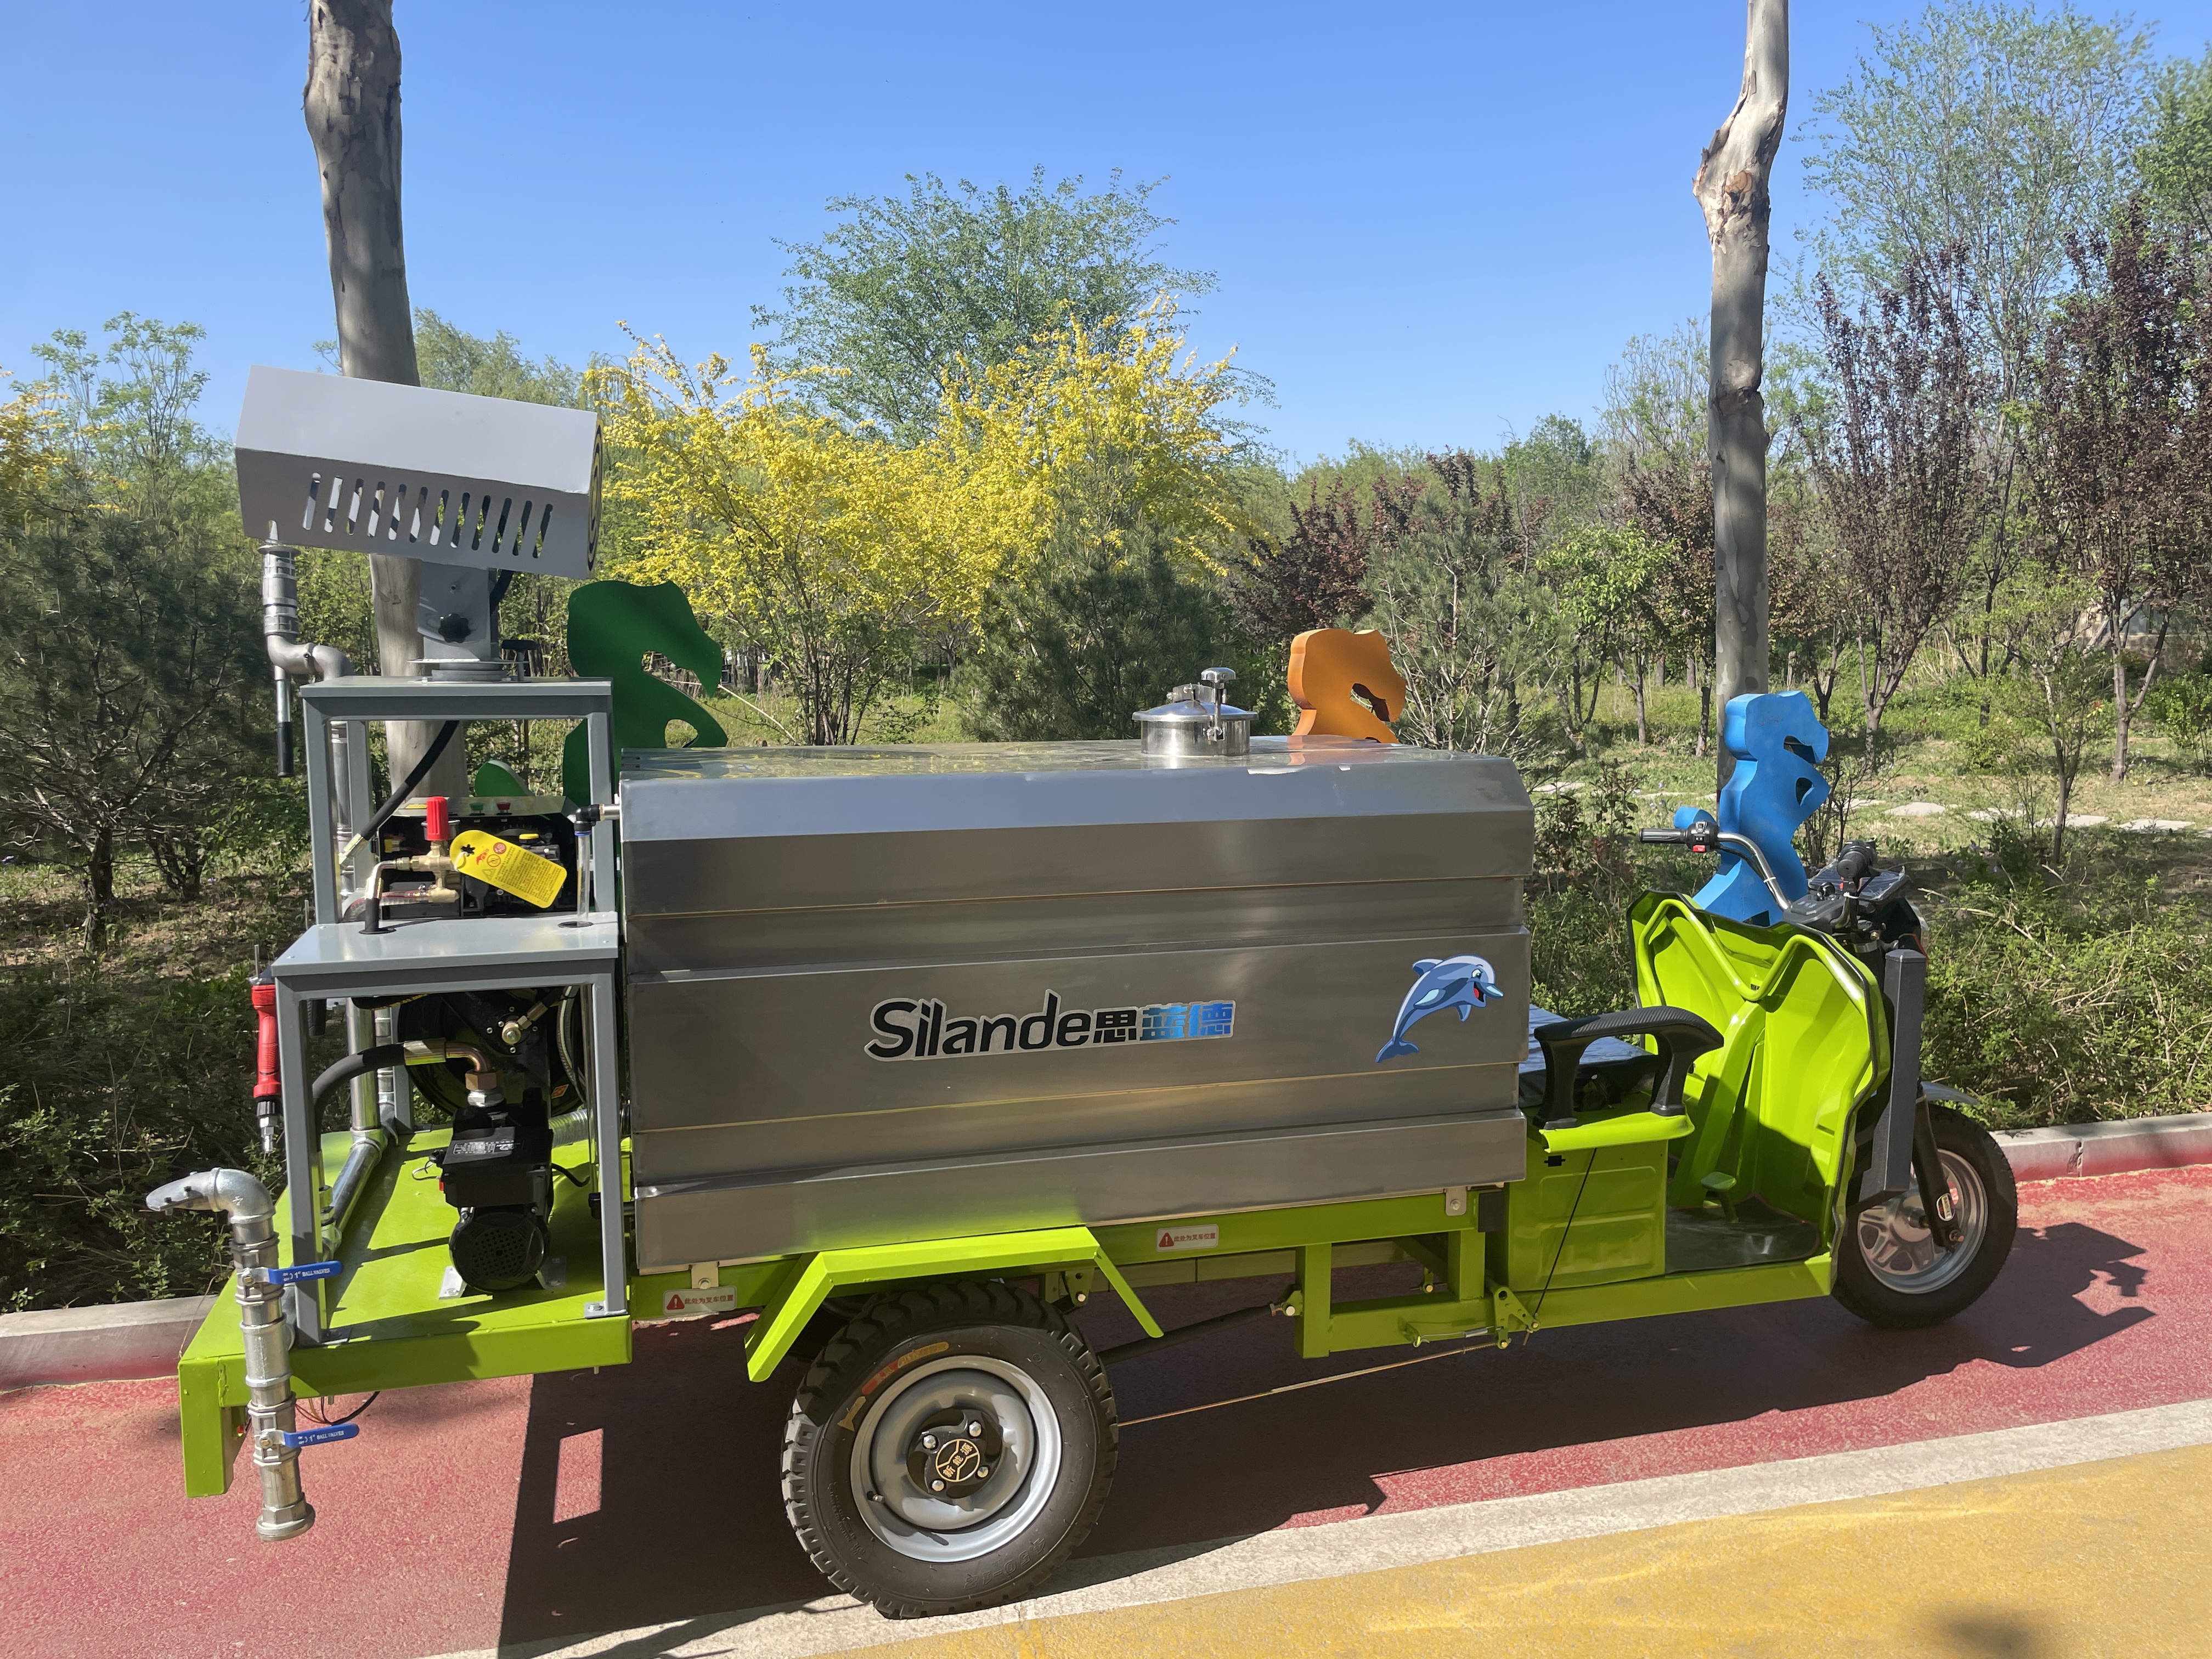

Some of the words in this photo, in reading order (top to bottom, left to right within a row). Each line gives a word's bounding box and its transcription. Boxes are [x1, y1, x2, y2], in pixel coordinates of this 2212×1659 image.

[868, 992, 1091, 1058] Silande
[1092, 1002, 1234, 1044] 思蓝德
[685, 1295, 733, 1304] 此处为叉车位置
[943, 1442, 973, 1478] 新能源
